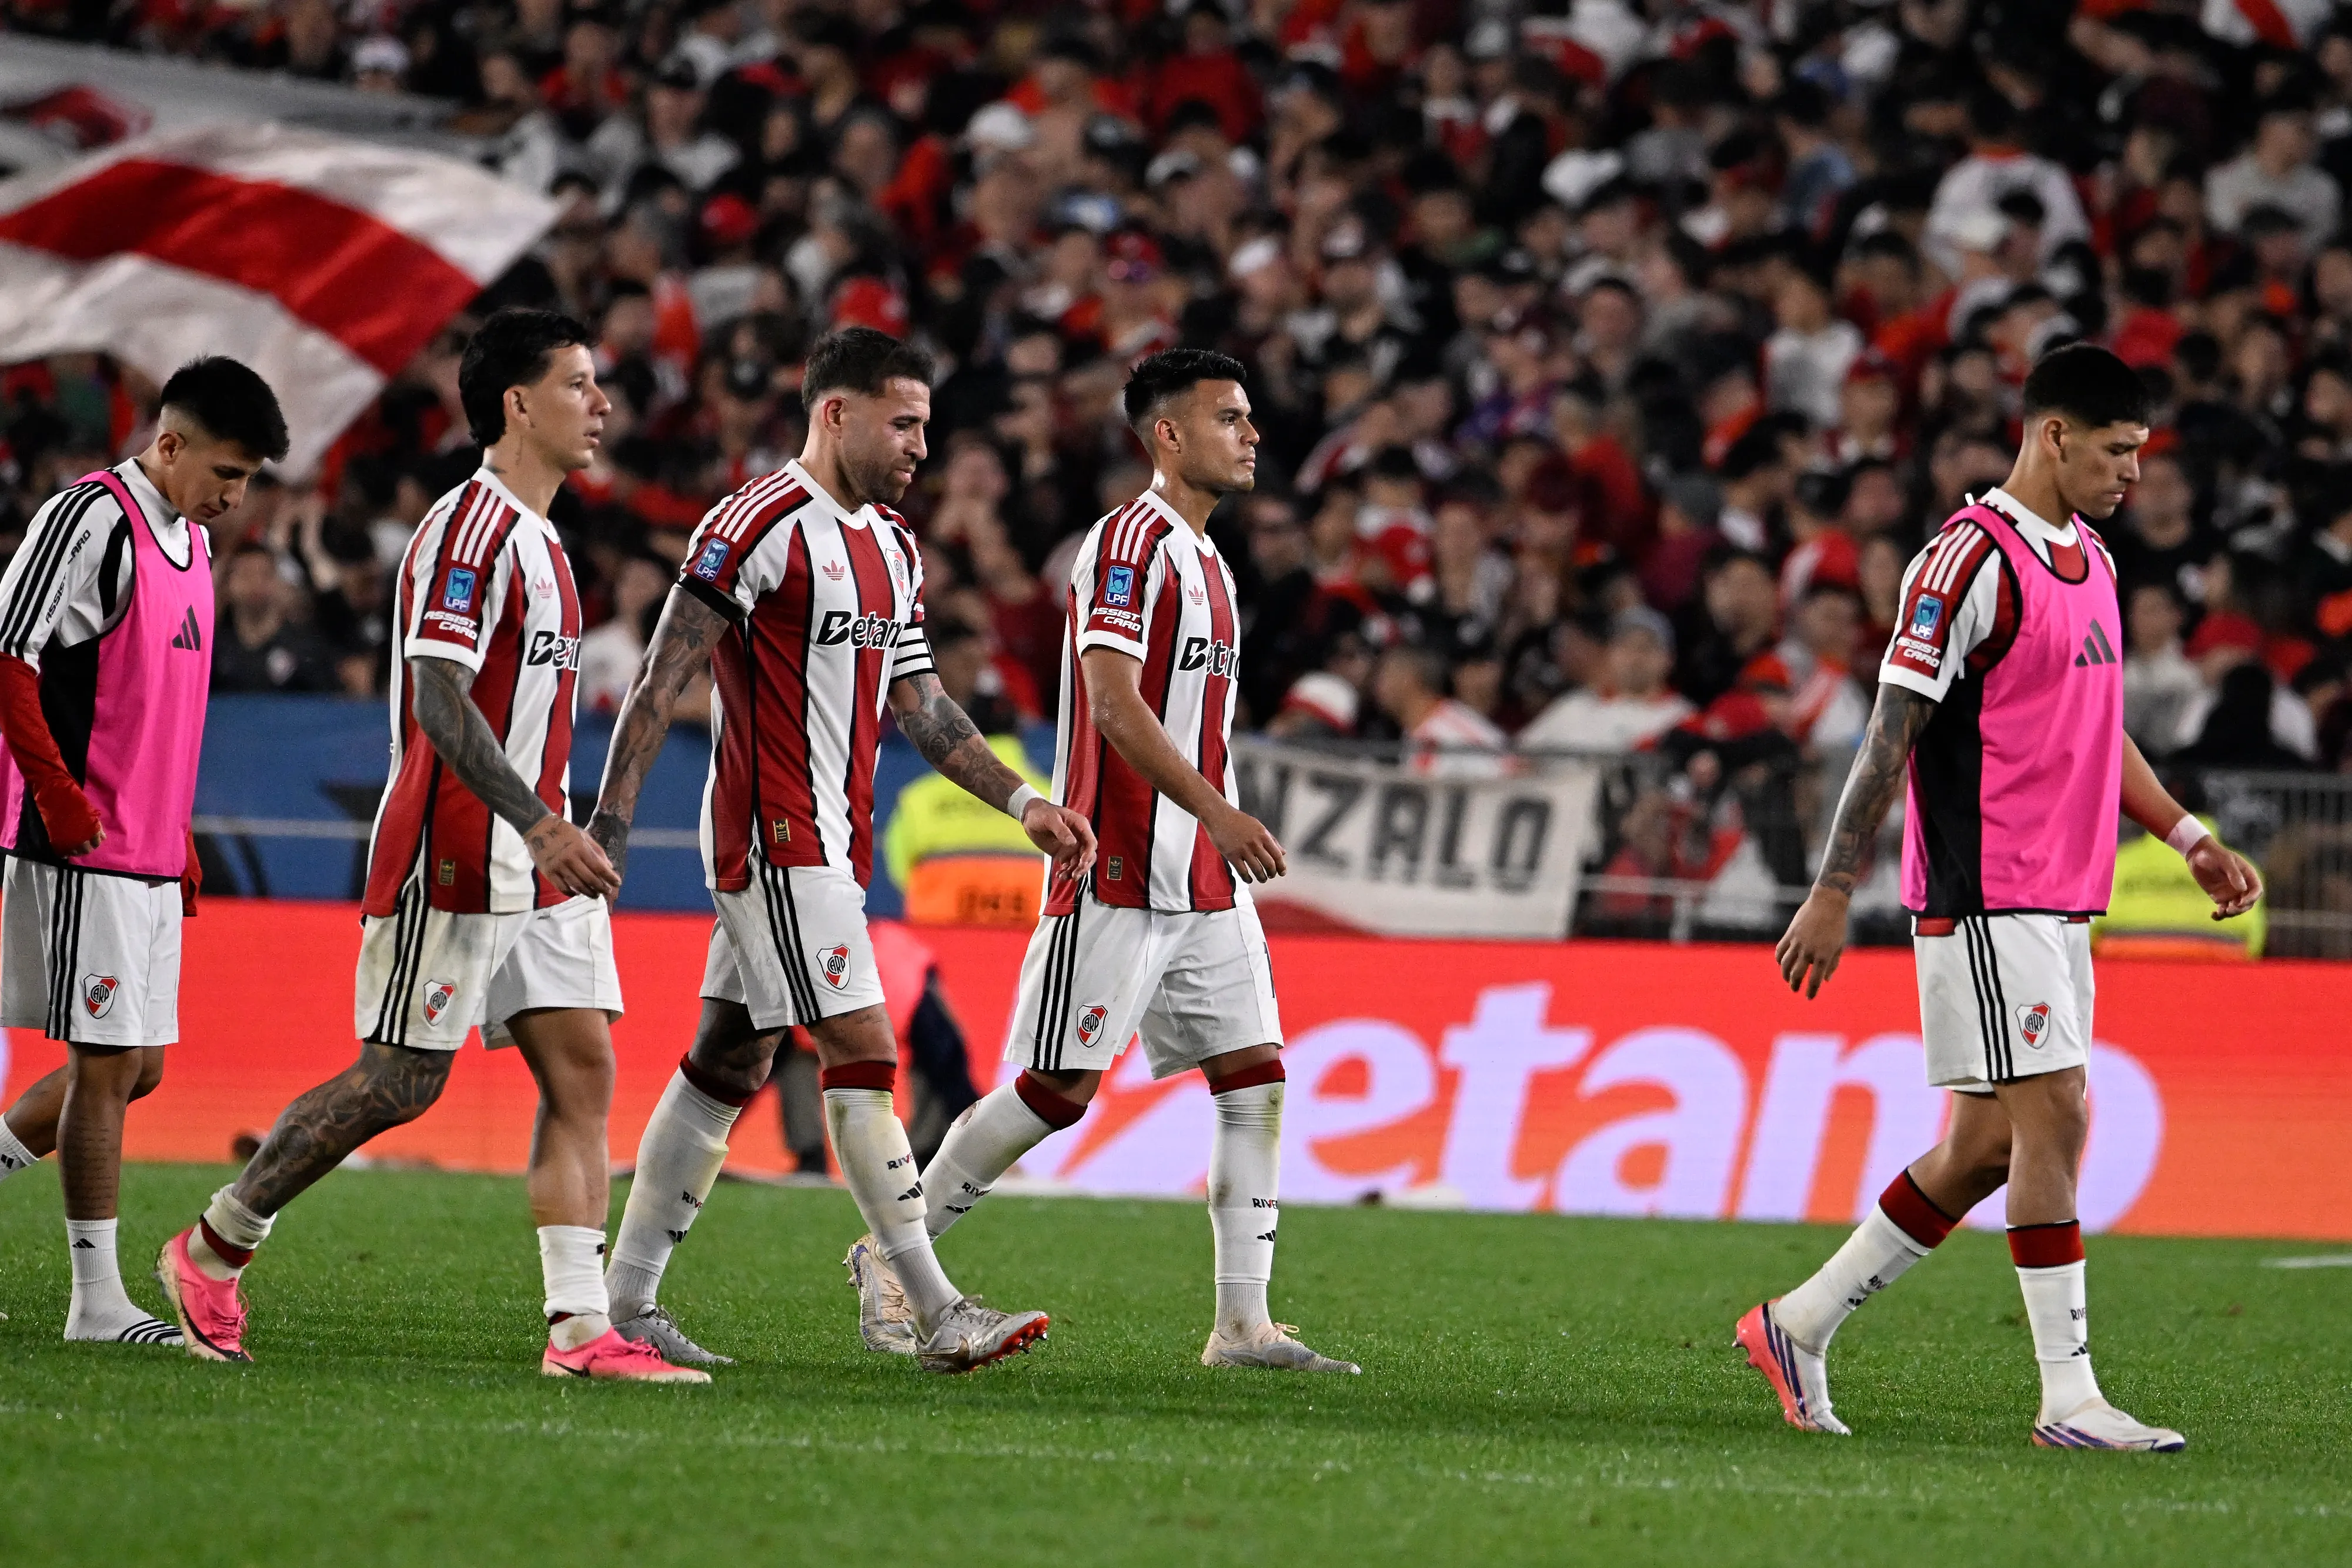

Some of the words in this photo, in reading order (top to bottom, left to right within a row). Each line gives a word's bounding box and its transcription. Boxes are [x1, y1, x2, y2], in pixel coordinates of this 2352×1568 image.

[68, 529, 91, 565] ARD
[696, 564, 716, 579] LPF
[445, 596, 468, 610] LPF
[1107, 593, 1128, 604] LPF
[423, 611, 477, 628] ASSIST
[1103, 616, 1141, 632] CARD
[439, 621, 477, 641] CARD
[815, 610, 903, 649] Betan
[1911, 623, 1932, 637] LPF
